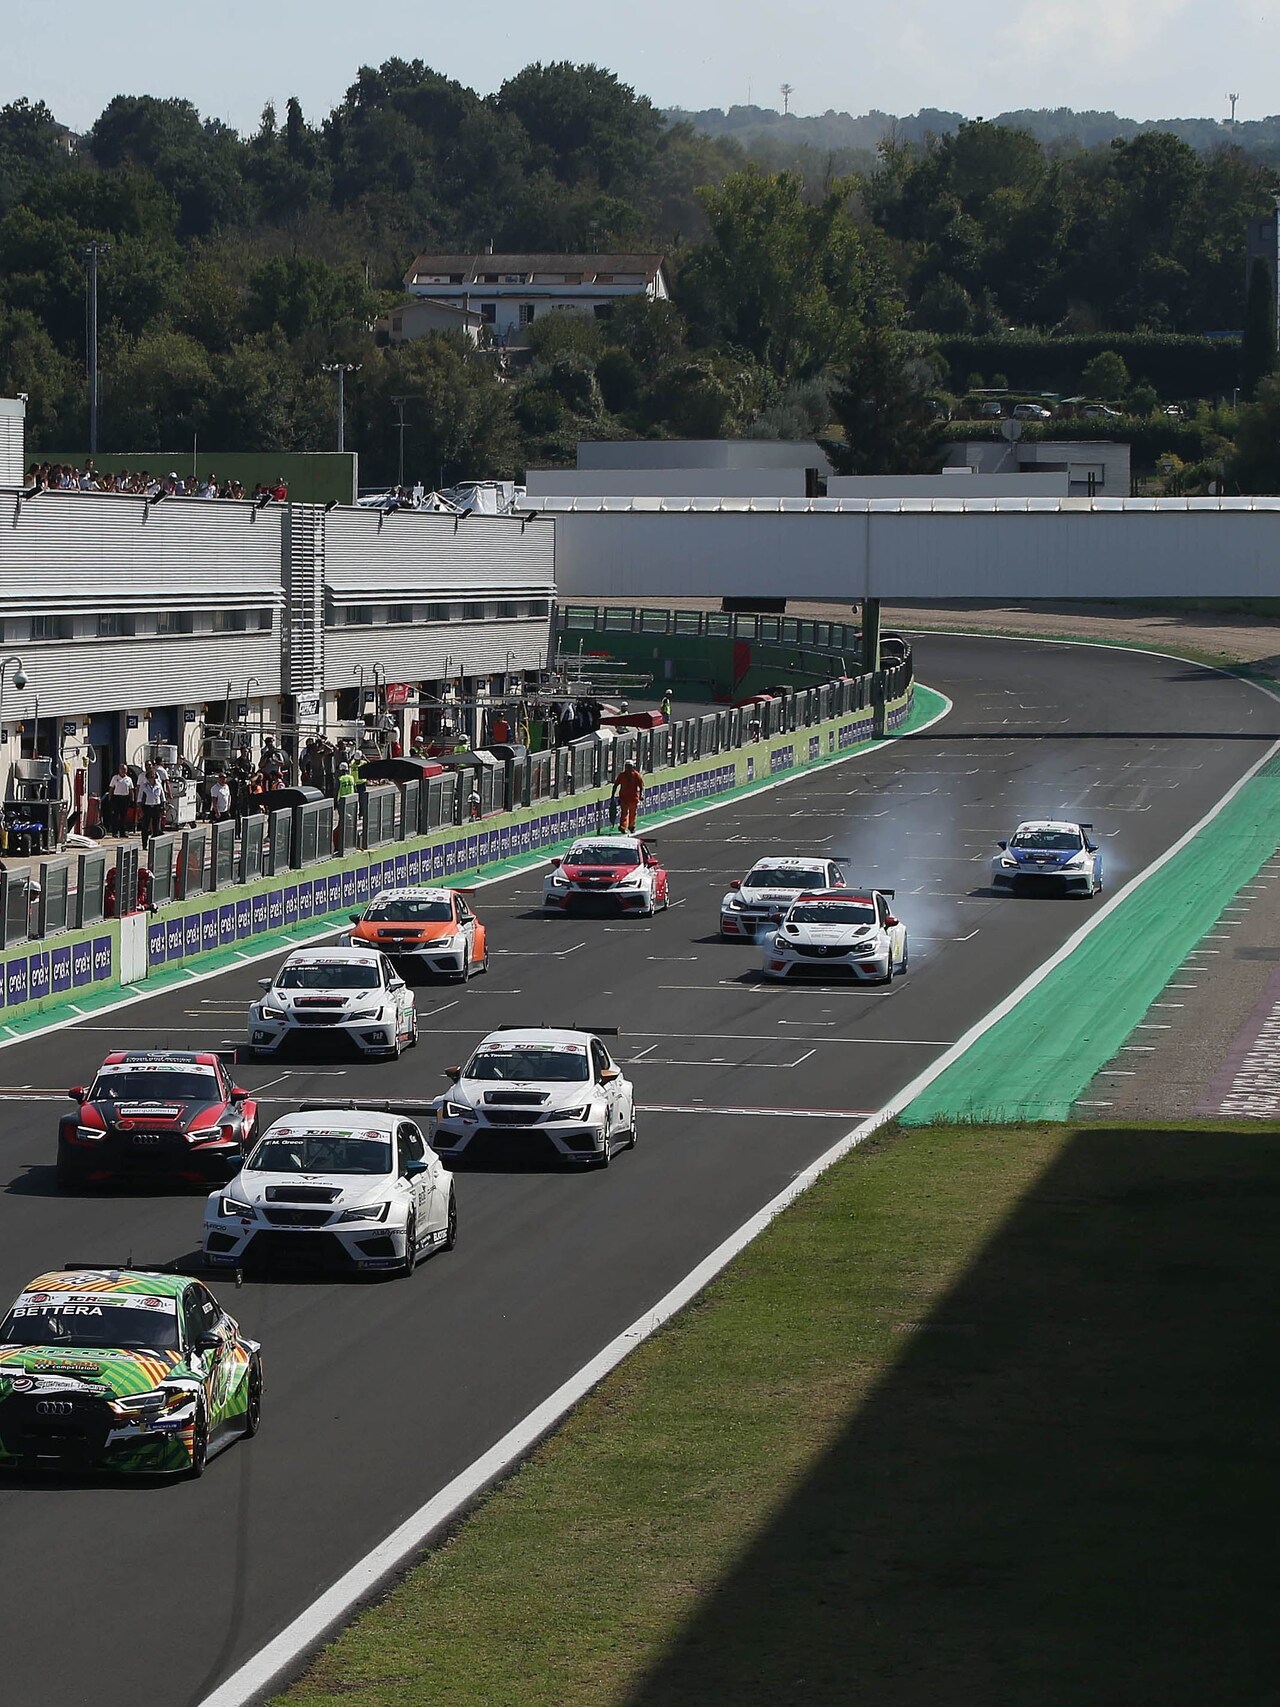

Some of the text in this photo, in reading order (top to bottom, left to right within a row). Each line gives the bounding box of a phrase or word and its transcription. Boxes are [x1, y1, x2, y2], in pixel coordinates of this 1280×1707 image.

[184, 712, 195, 721] 20
[64, 725, 76, 734] 22
[12, 1305, 103, 1318] BETTERA
